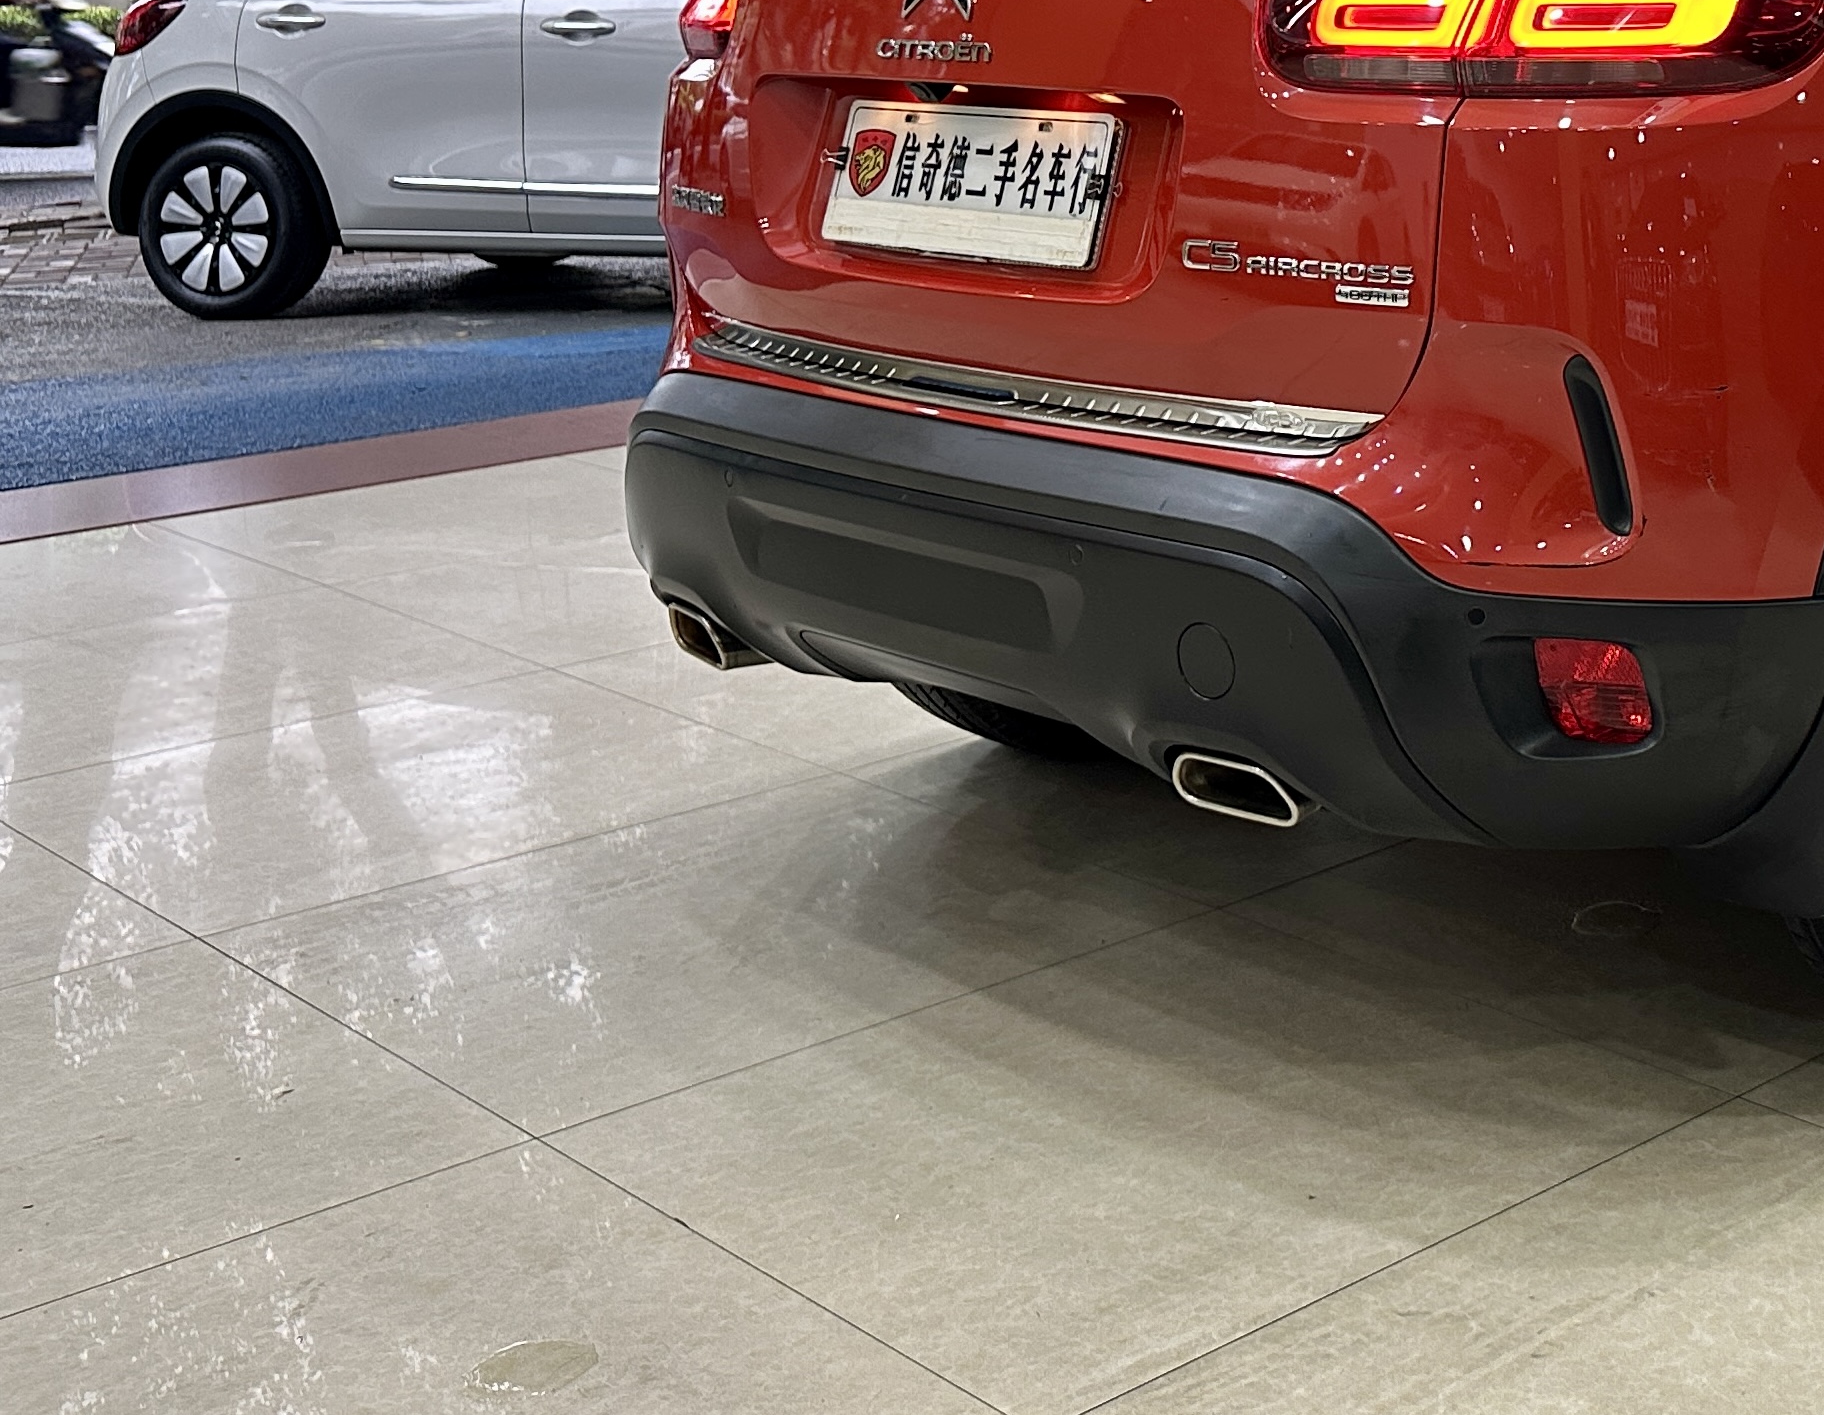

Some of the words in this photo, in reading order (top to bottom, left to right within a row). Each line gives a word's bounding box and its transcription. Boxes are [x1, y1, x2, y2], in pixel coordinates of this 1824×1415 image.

[876, 32, 991, 62] CITROËN
[891, 132, 1102, 215] 信奇德二手名车行
[1181, 239, 1241, 272] C5
[1246, 256, 1414, 285] AIRCROSS
